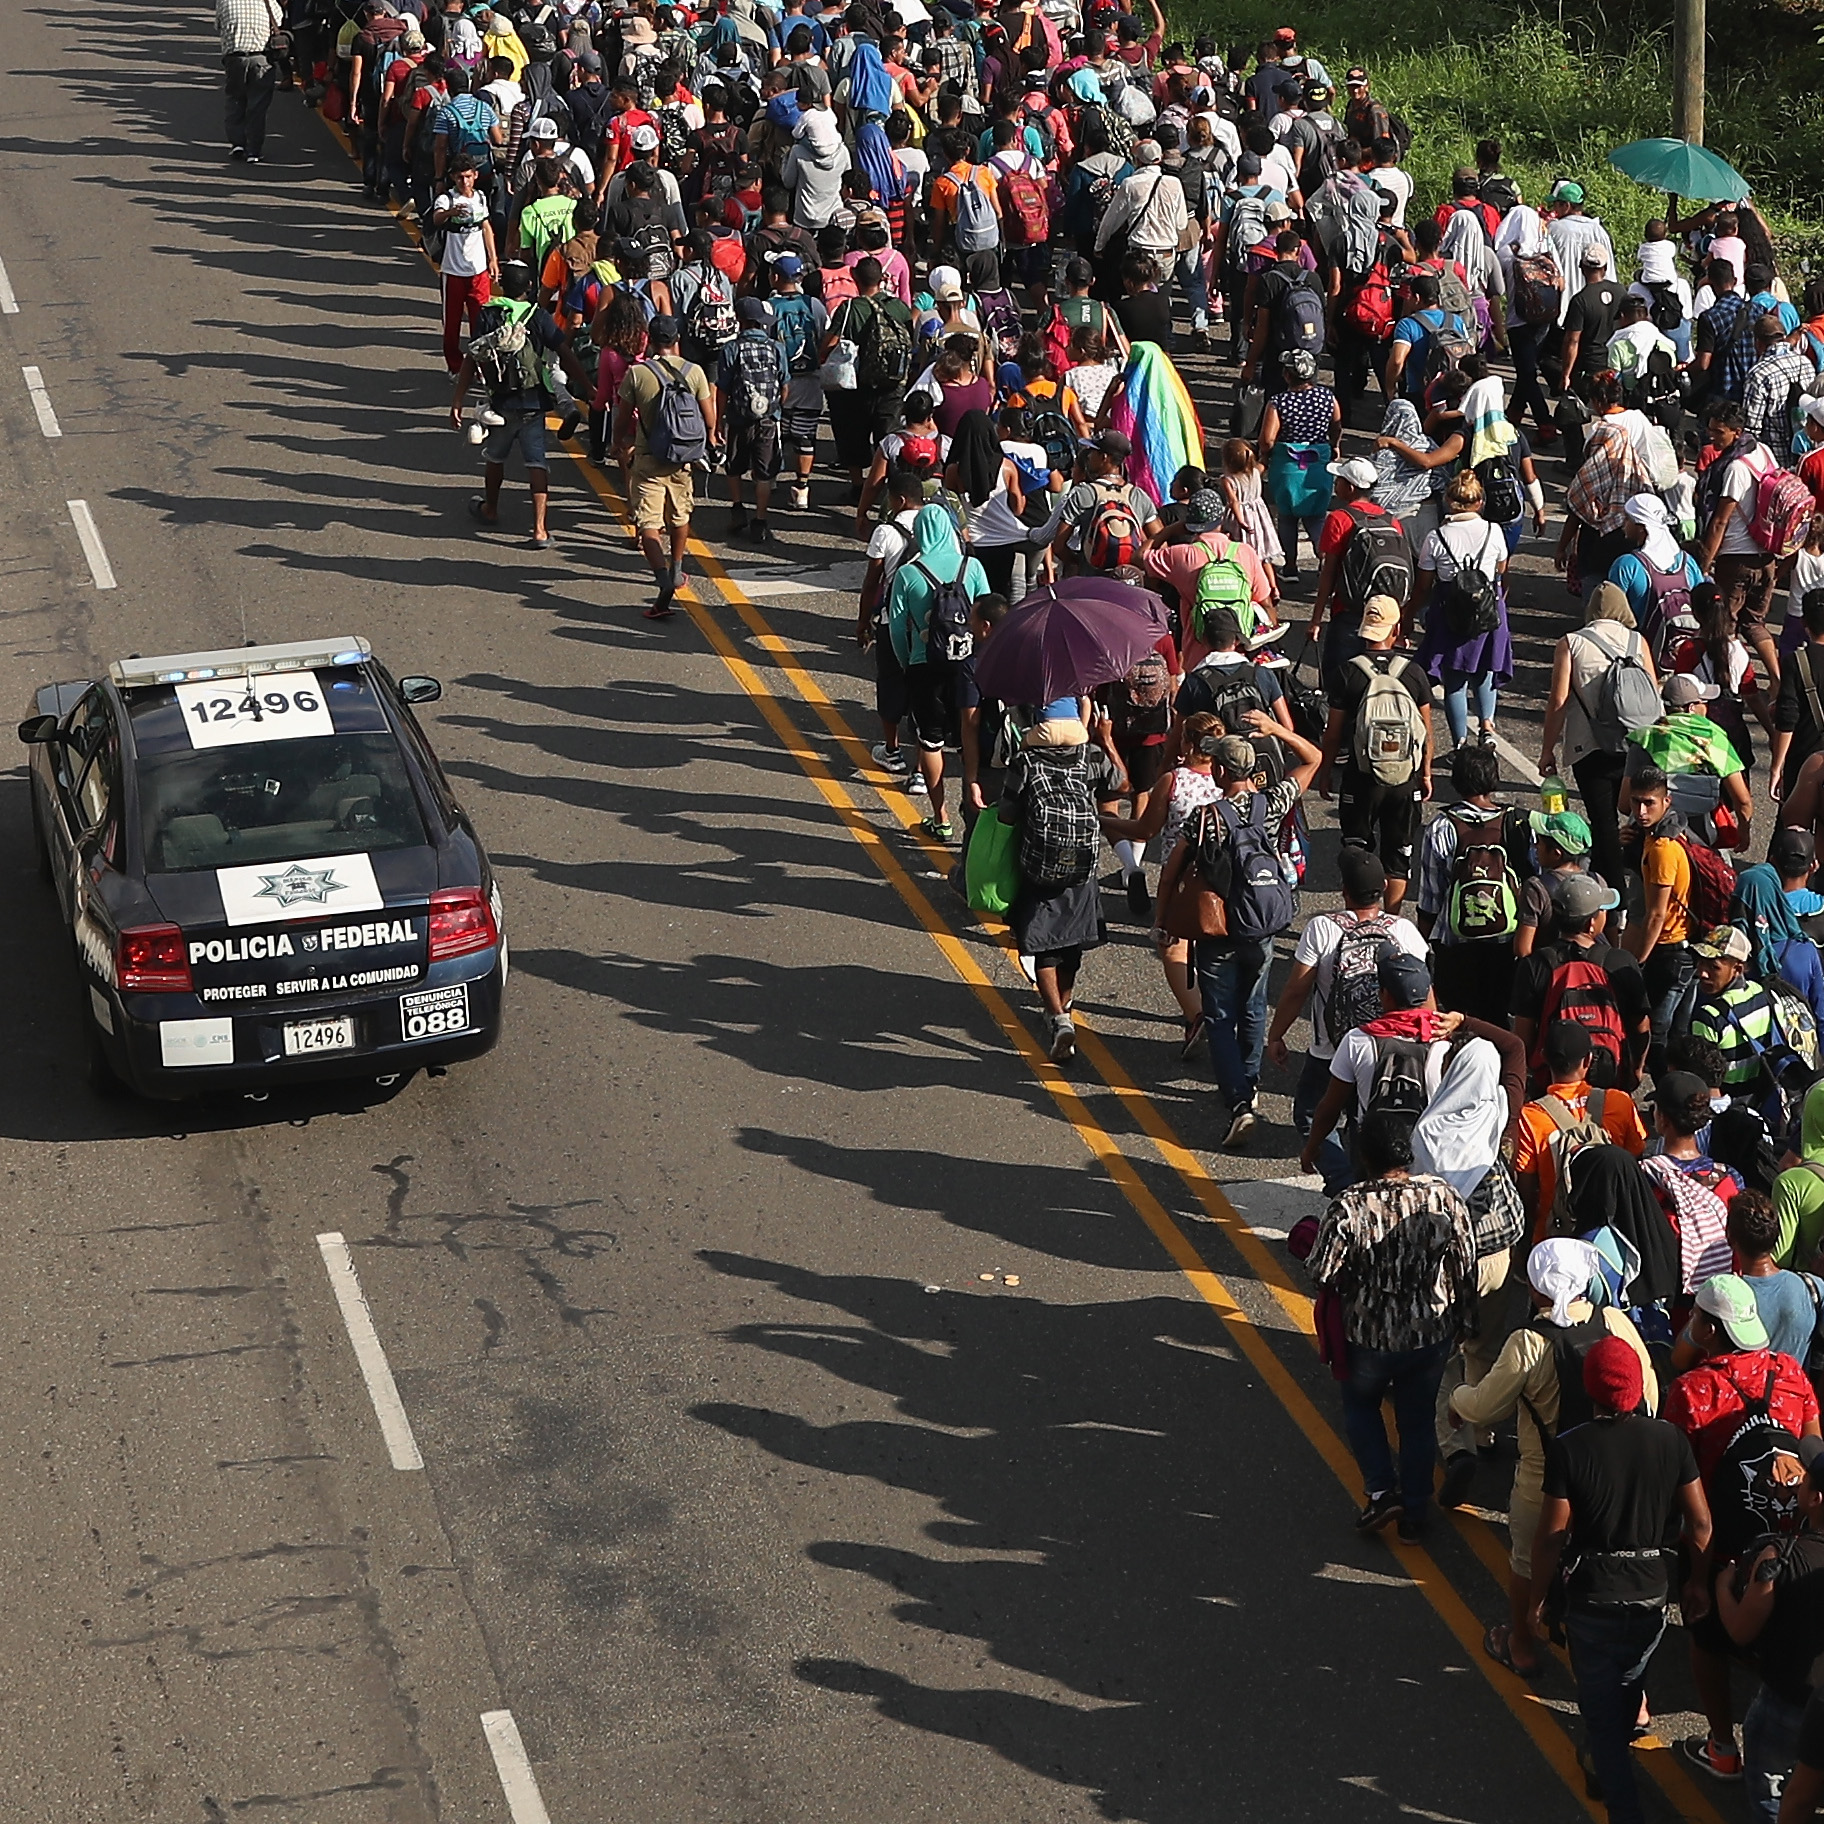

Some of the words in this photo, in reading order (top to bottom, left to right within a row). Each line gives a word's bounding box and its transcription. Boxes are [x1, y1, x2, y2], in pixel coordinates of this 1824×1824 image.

[190, 691, 318, 723] 12496
[189, 933, 294, 964] POLICIA
[321, 919, 418, 951] FEDERAL
[203, 984, 267, 1001] PROTEGER
[276, 977, 319, 994] SERVIR
[320, 977, 330, 990] A
[333, 976, 348, 990] LA
[350, 965, 419, 988] COMUNIDAD
[406, 988, 462, 1007] DENUNCIA
[407, 1008, 464, 1037] 088
[293, 1026, 345, 1050] 12496
